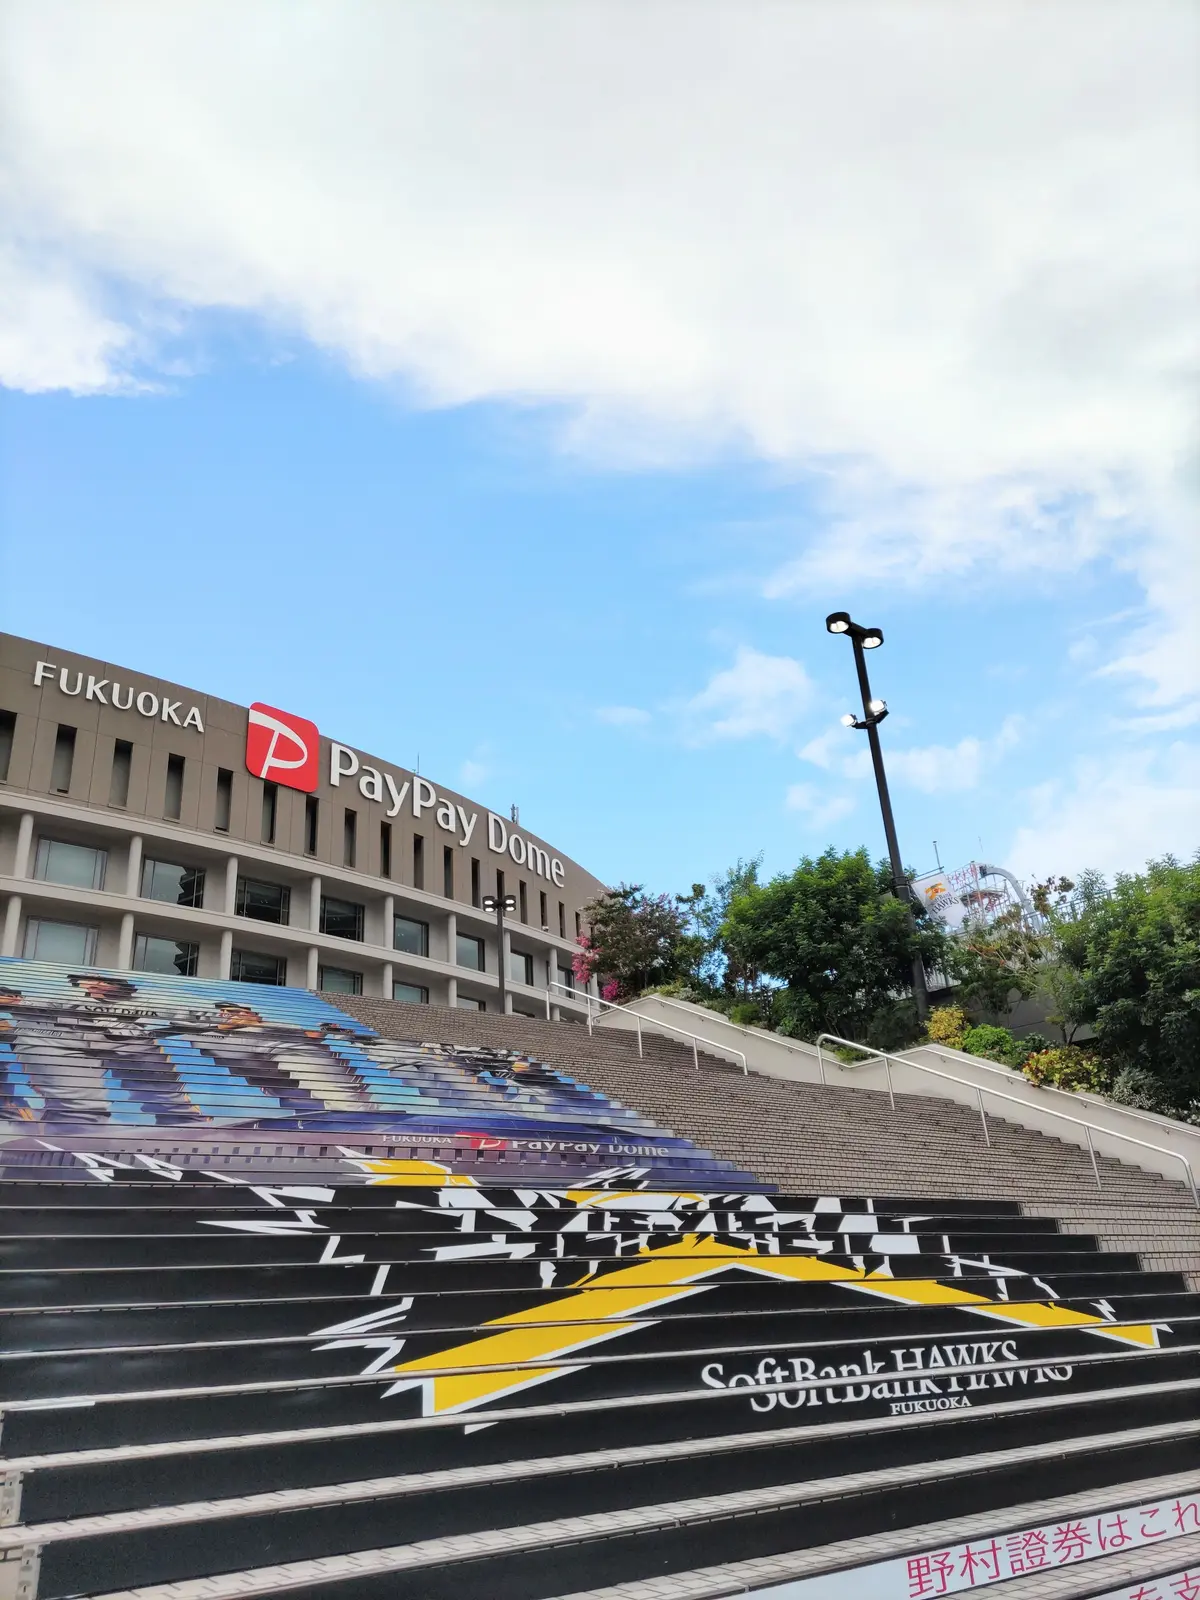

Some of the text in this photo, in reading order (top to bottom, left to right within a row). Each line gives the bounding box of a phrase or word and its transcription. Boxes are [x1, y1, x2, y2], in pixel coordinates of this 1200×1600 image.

[33, 660, 205, 733] FUKUOKA
[329, 742, 478, 848] PayPay
[487, 811, 565, 888] Dome
[889, 1395, 972, 1416] FUKUOKA
